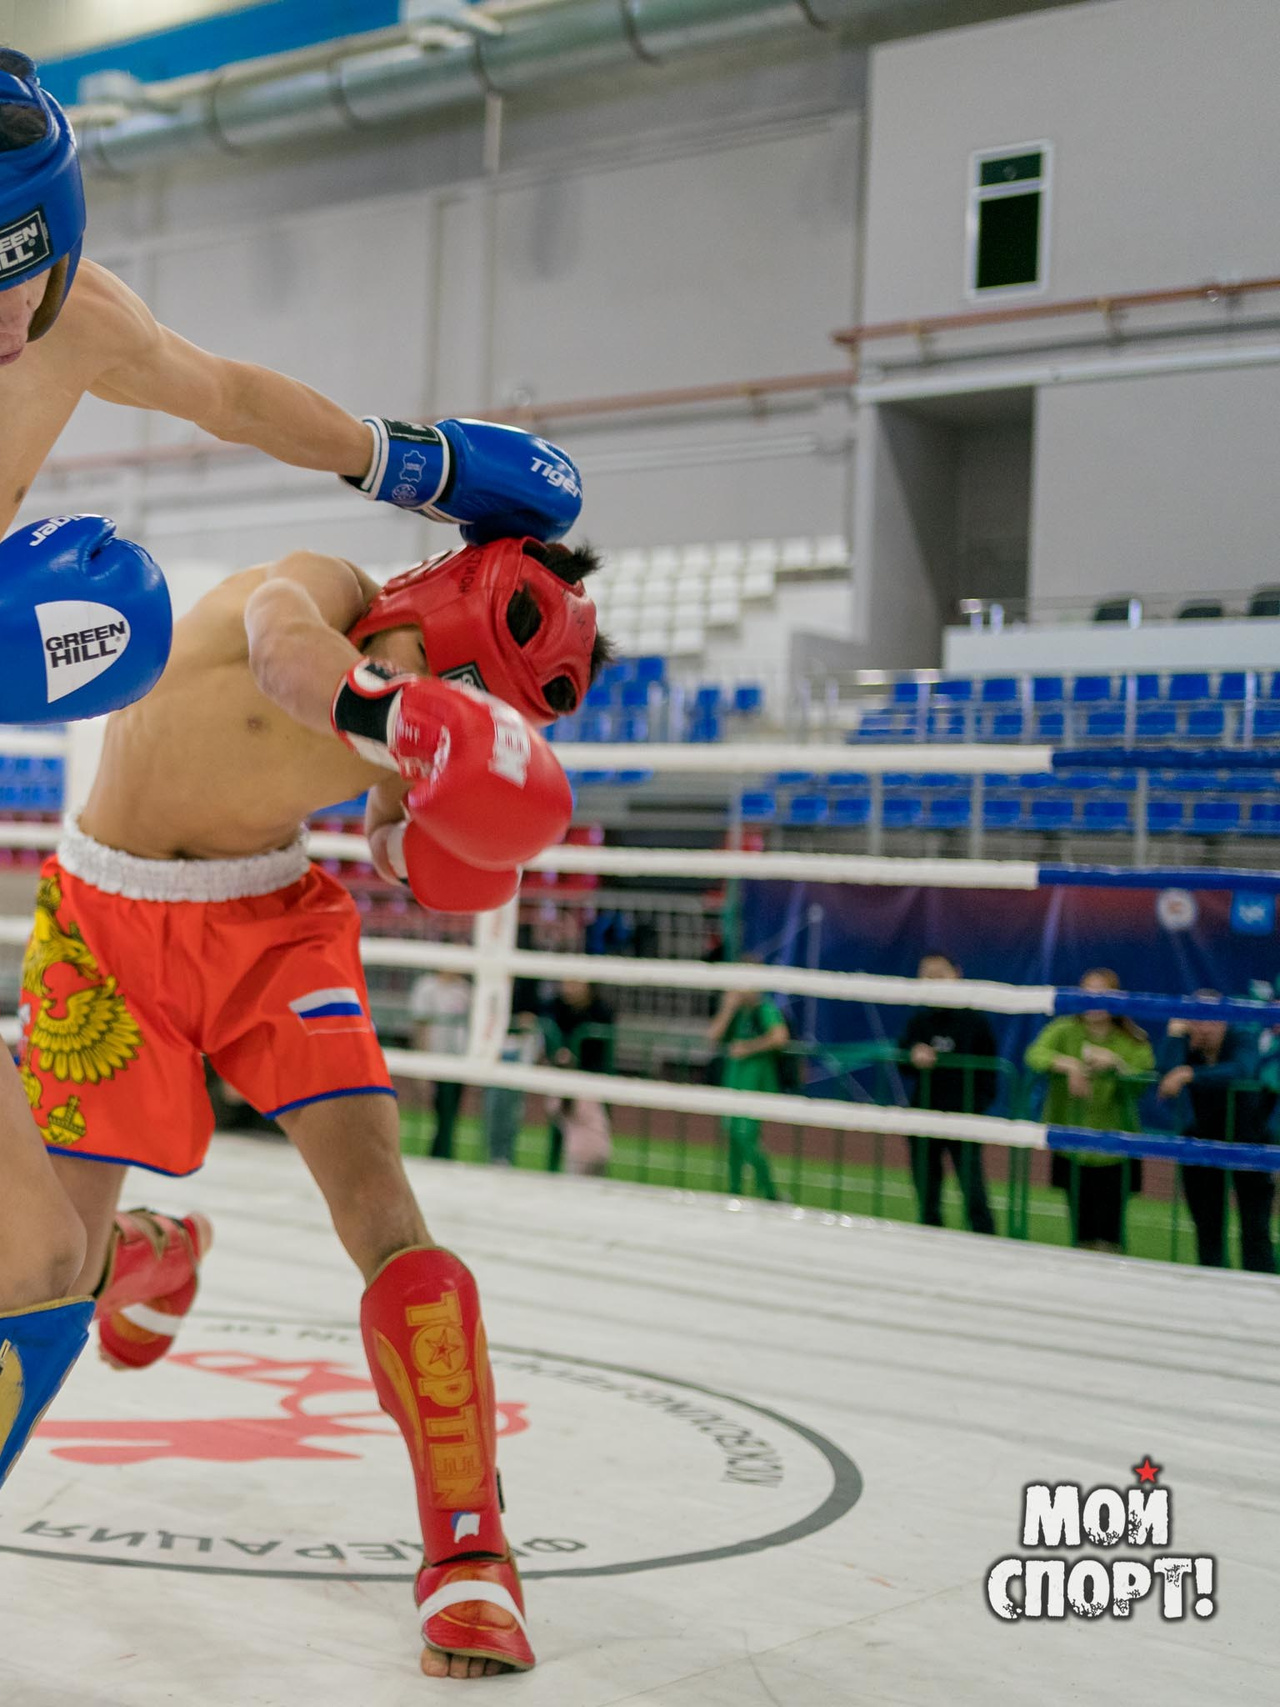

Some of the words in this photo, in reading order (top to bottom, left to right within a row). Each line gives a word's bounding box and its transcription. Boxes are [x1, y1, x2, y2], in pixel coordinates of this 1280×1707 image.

[531, 456, 583, 499] Tiger
[46, 621, 125, 651] GREEN
[50, 640, 117, 668] HILL
[21, 1520, 587, 1562] ФЕРАЦИЯ
